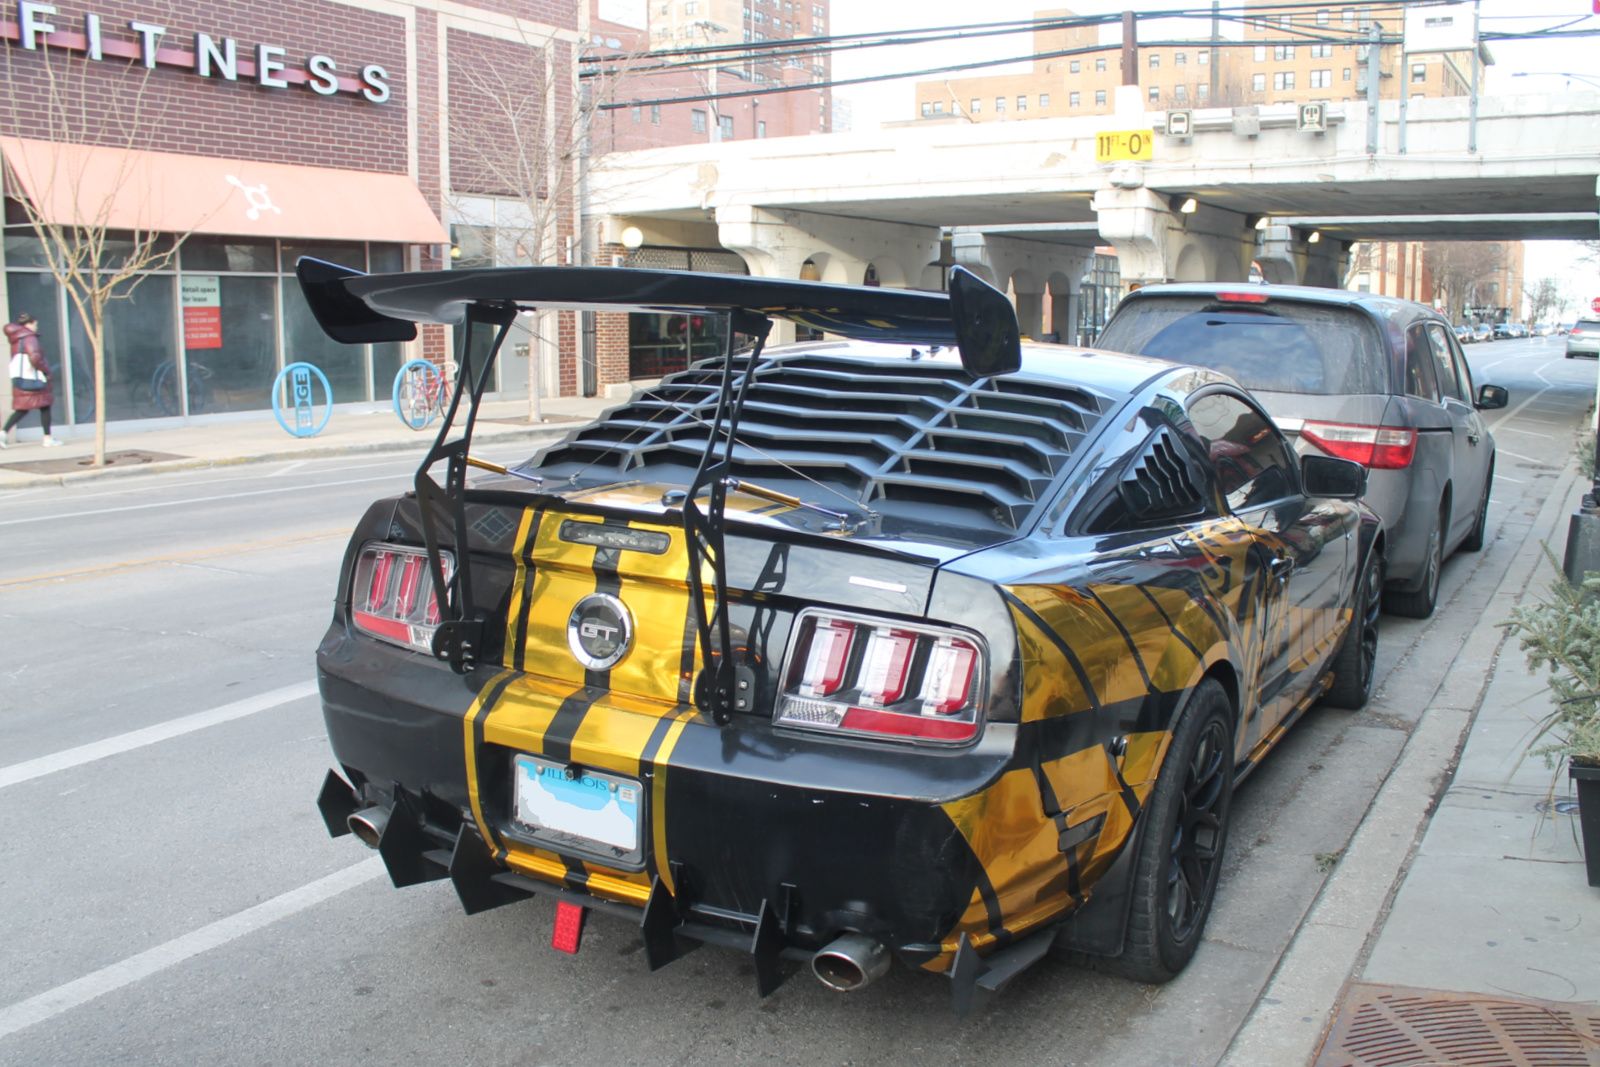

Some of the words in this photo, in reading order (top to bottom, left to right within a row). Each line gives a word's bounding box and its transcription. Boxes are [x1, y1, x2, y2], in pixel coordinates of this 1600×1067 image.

[18, 0, 391, 104] FITNESS
[580, 622, 619, 641] GT
[547, 768, 608, 791] ILLOIS
